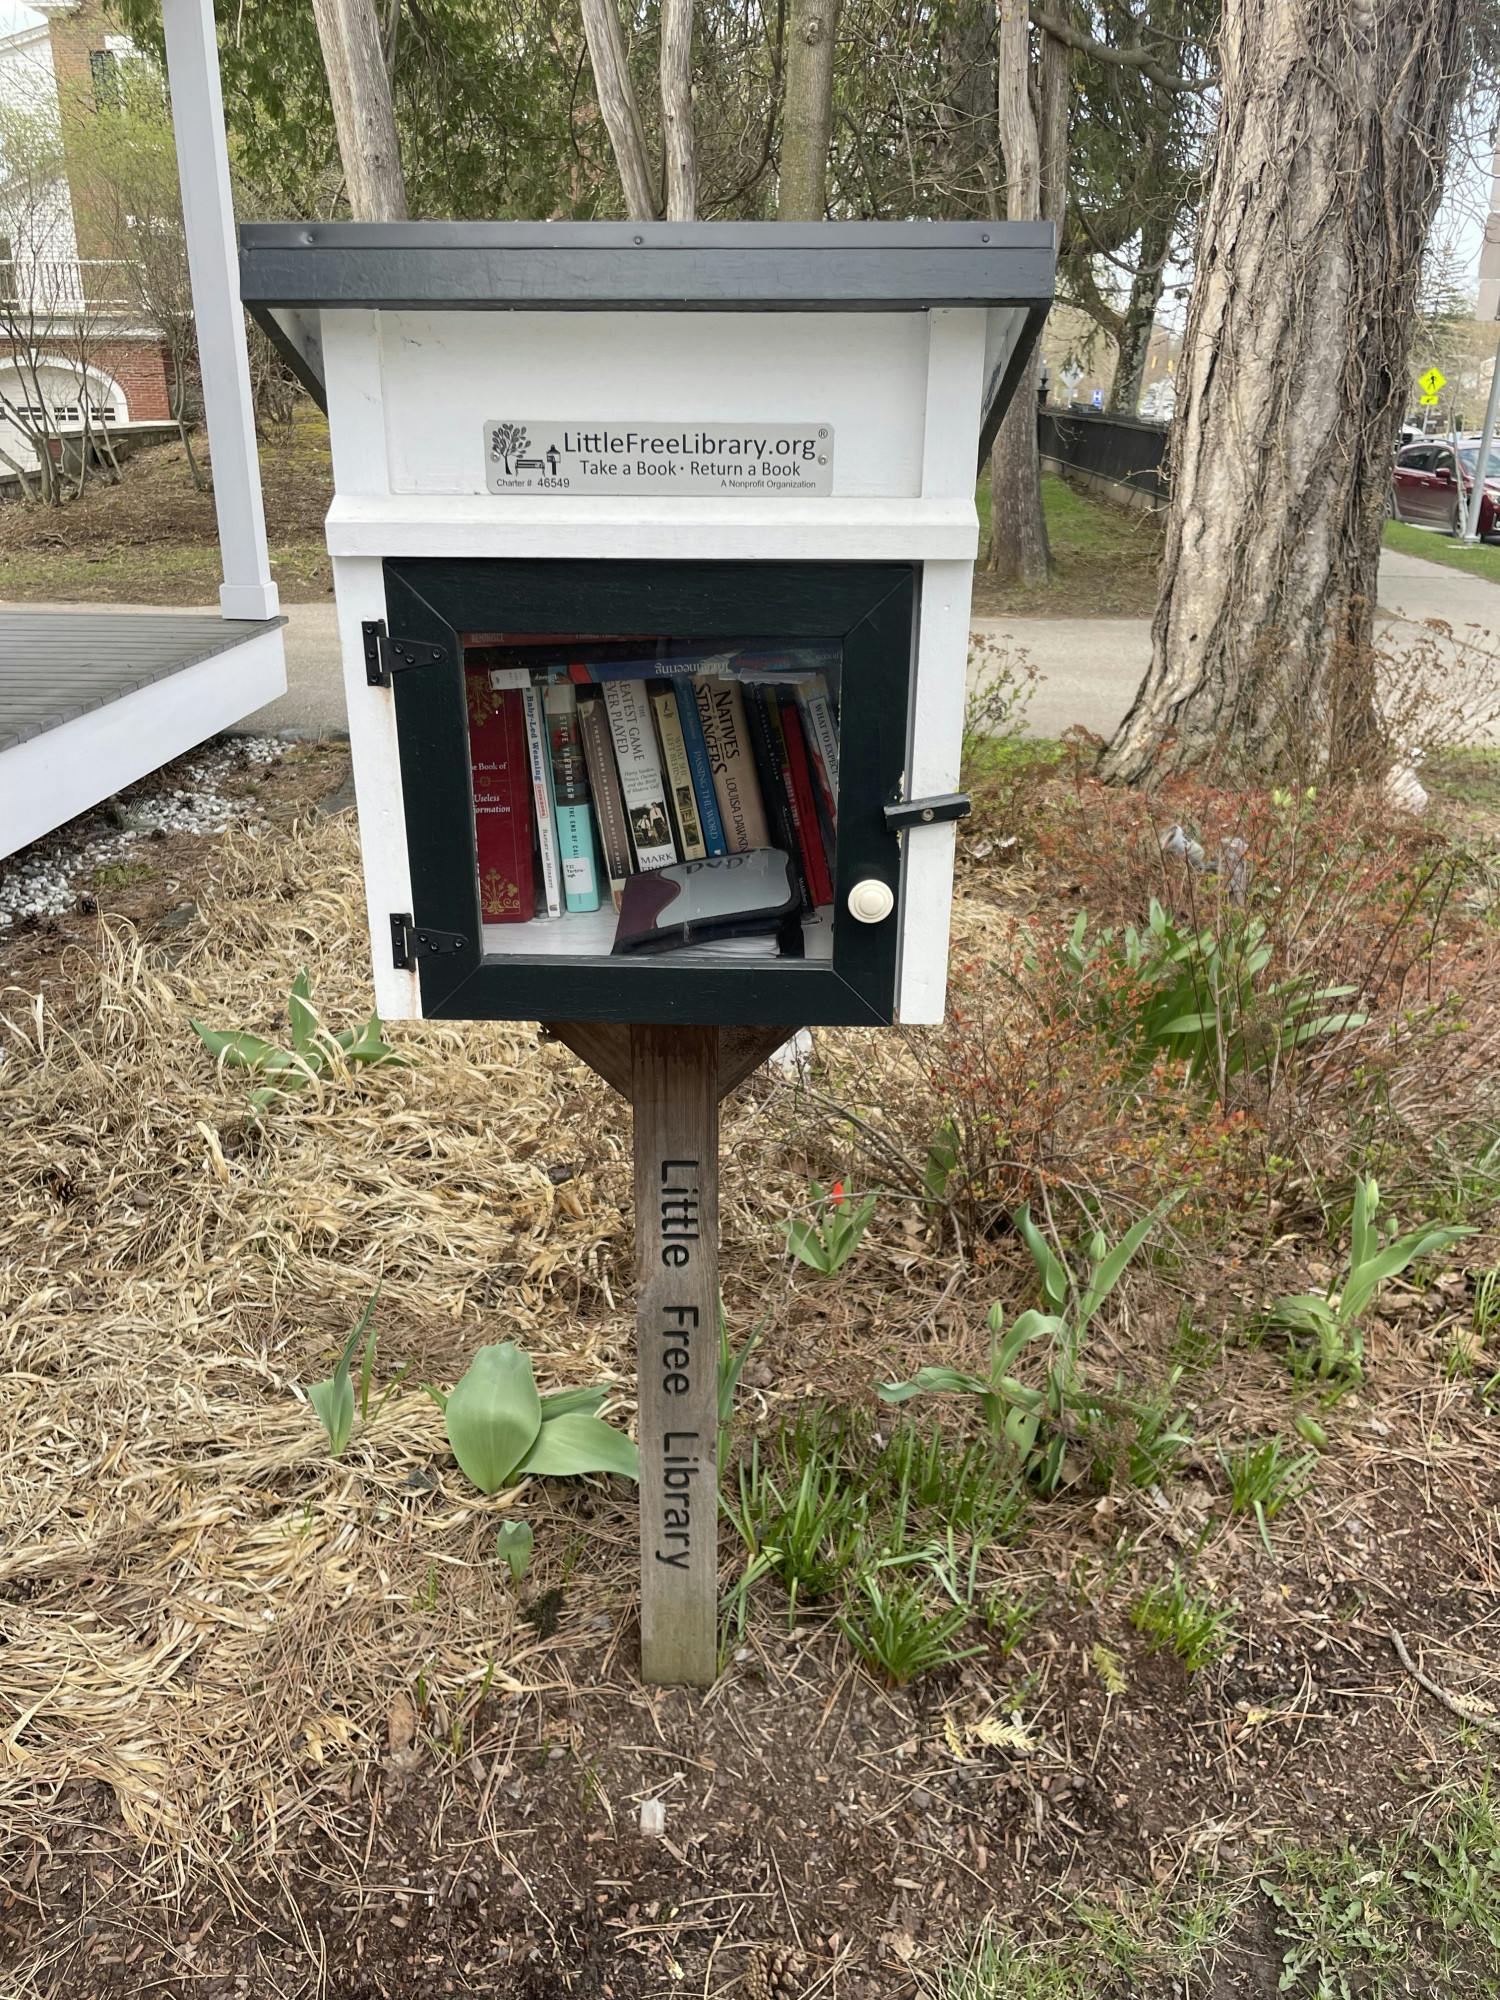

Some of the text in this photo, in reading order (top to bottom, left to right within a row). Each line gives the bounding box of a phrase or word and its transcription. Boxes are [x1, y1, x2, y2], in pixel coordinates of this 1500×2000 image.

[564, 432, 816, 460] LittleFreeLibrary.org
[496, 478, 525, 488] Charter
[537, 478, 570, 488] 46549
[579, 460, 801, 477] Take a Book Return a Book
[720, 480, 816, 490] A Nonprofit Organization
[526, 695, 537, 739] Baby-Led
[559, 715, 569, 743] STEVE
[611, 711, 629, 754] PLAYED
[620, 680, 645, 761] EATEST GAME
[693, 682, 728, 775] STRANGERS
[713, 689, 740, 760] NATIVES
[814, 704, 827, 730] WHAT
[821, 731, 831, 743] TO
[478, 762, 497, 771] Book
[499, 761, 508, 770] of
[531, 742, 542, 784] Weaning
[474, 793, 500, 802] Useless
[568, 807, 576, 818] THE
[725, 777, 749, 852] LOUISA DAWKIN
[640, 852, 673, 864] MARK
[655, 1159, 700, 1571] Little Free Library
